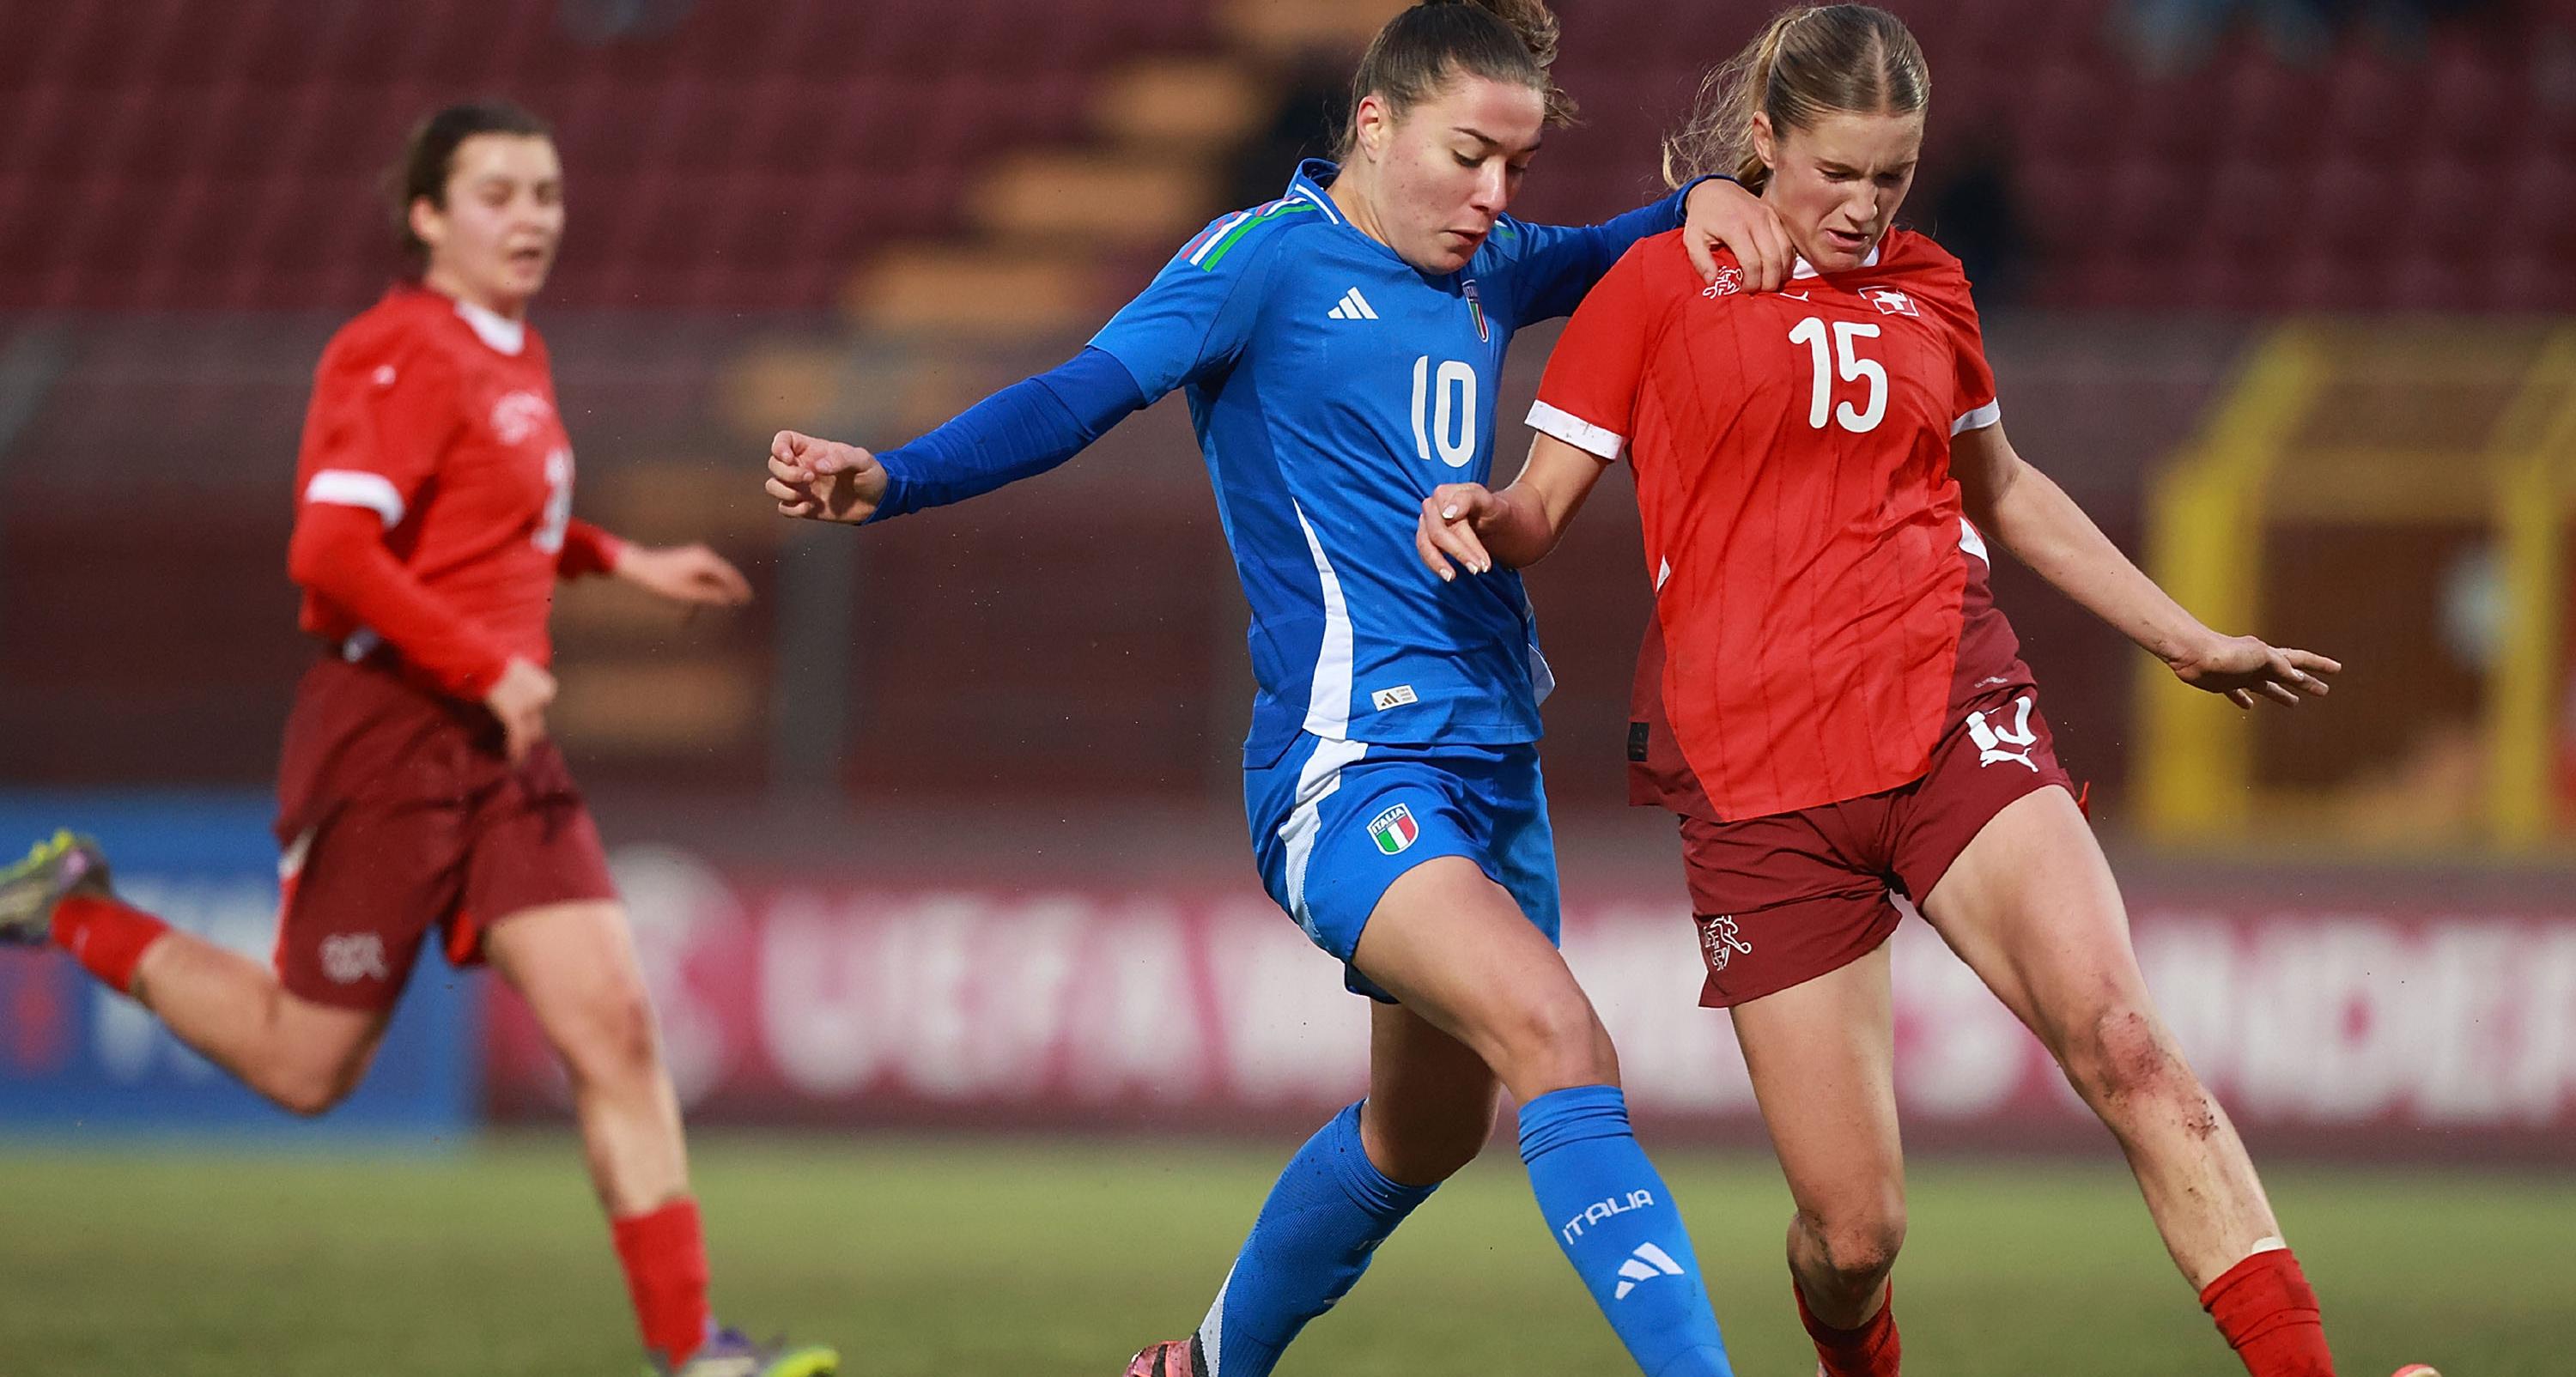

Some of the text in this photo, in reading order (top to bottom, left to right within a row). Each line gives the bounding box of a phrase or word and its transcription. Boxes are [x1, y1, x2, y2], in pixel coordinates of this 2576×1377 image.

[1411, 355, 1477, 469] 10
[1789, 317, 1888, 434] 15
[1371, 805, 1406, 834] ITALIA
[1562, 1188, 1655, 1246] ITALIA
